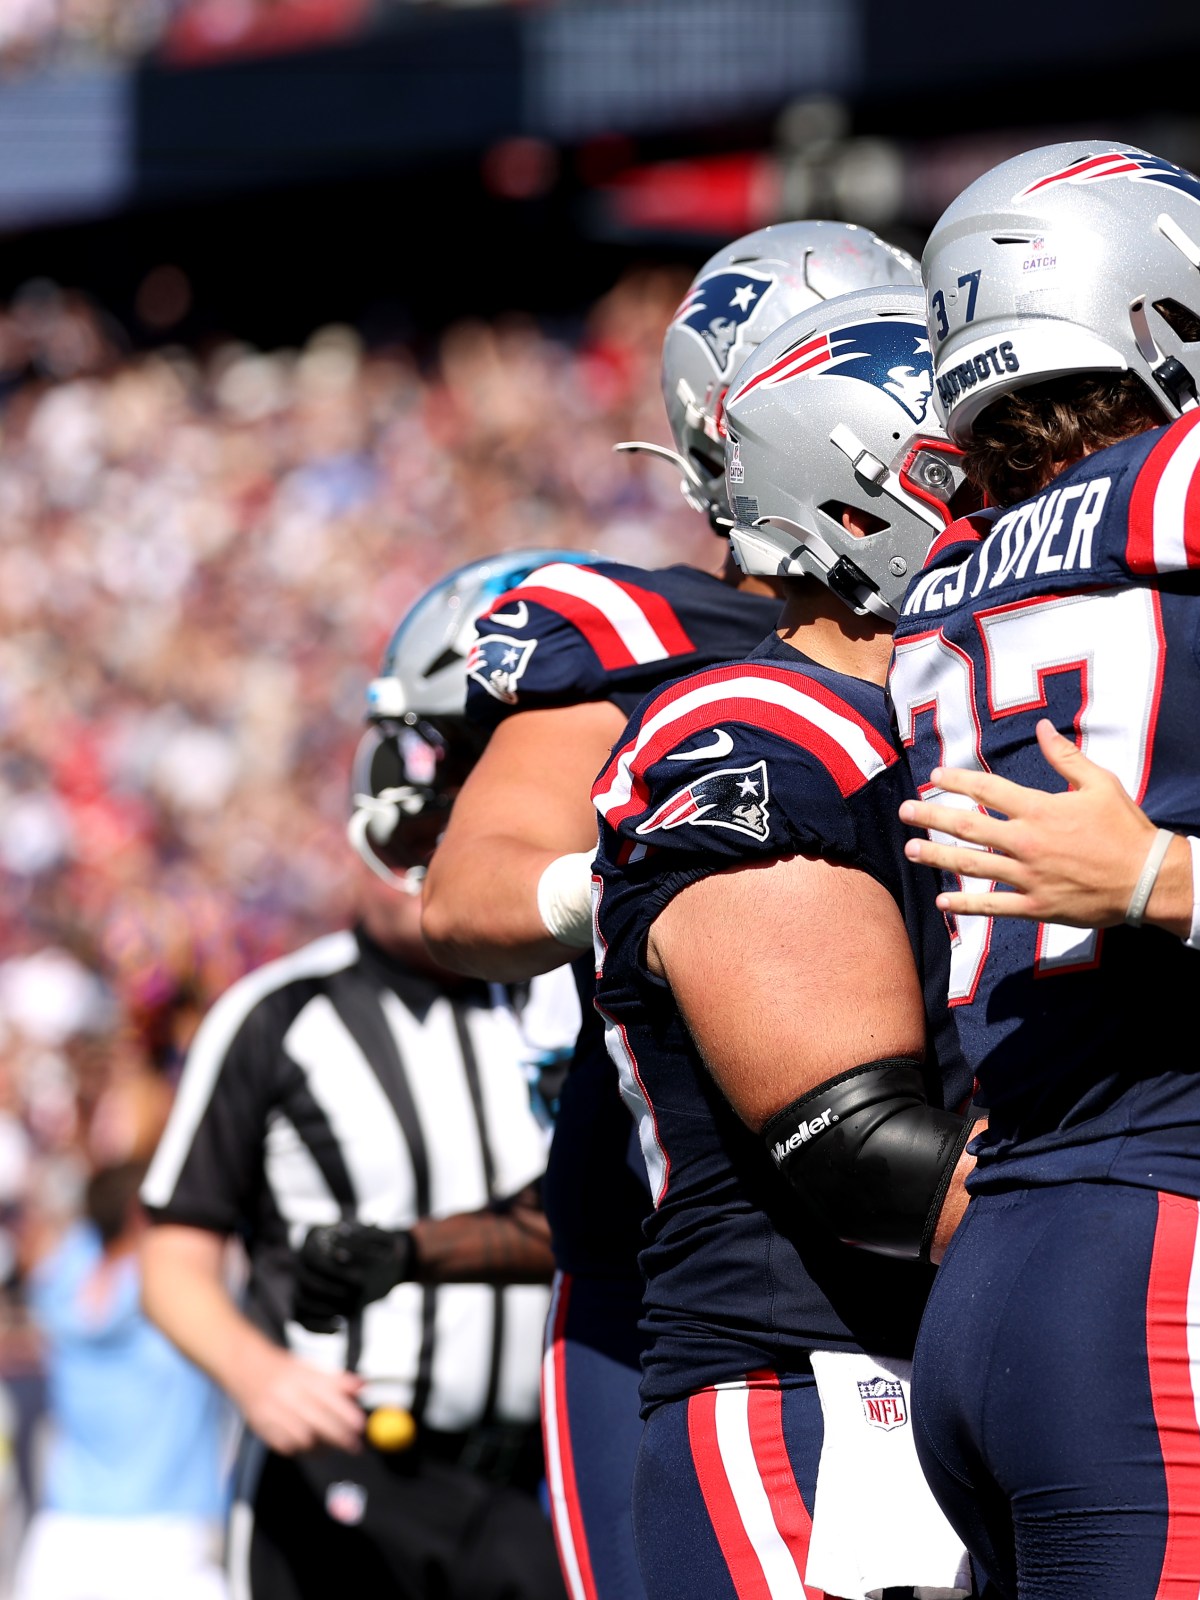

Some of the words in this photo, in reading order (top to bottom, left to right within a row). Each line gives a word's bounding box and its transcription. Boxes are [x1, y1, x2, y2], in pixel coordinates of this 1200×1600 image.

[1022, 255, 1057, 270] CATCH
[932, 269, 982, 341] 37
[865, 1398, 904, 1425] NFL
